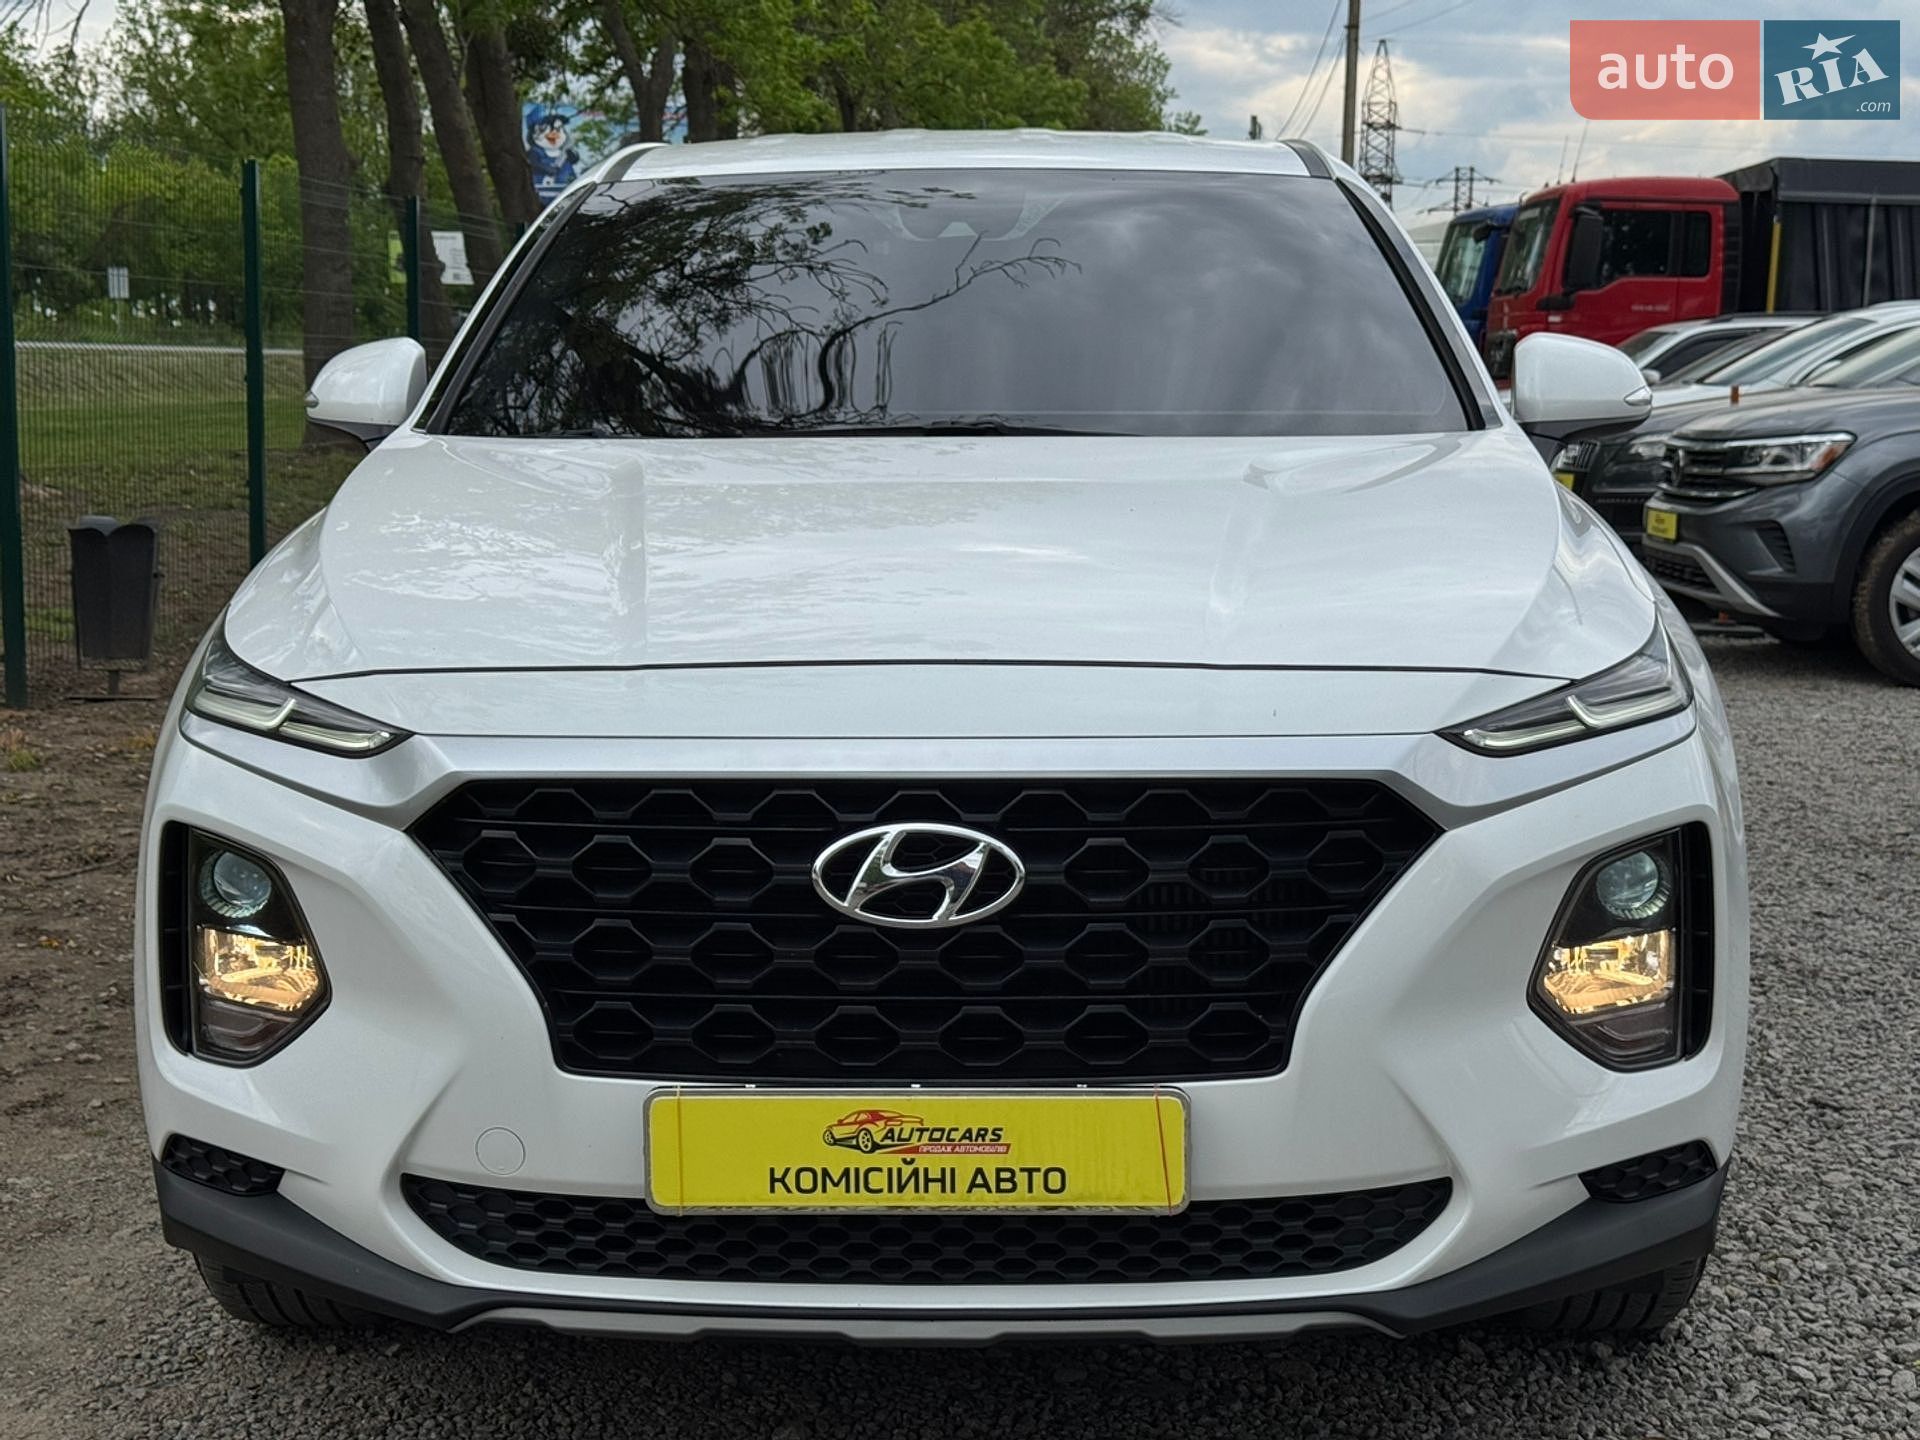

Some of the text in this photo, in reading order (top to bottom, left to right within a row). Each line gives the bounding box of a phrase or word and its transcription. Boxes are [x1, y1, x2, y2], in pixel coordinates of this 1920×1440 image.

[880, 1127, 1004, 1143] AUTOCARS
[918, 1144, 952, 1153] ПРОДАЖ
[768, 1157, 1068, 1195] КОМІСІЙНІ АВТО
